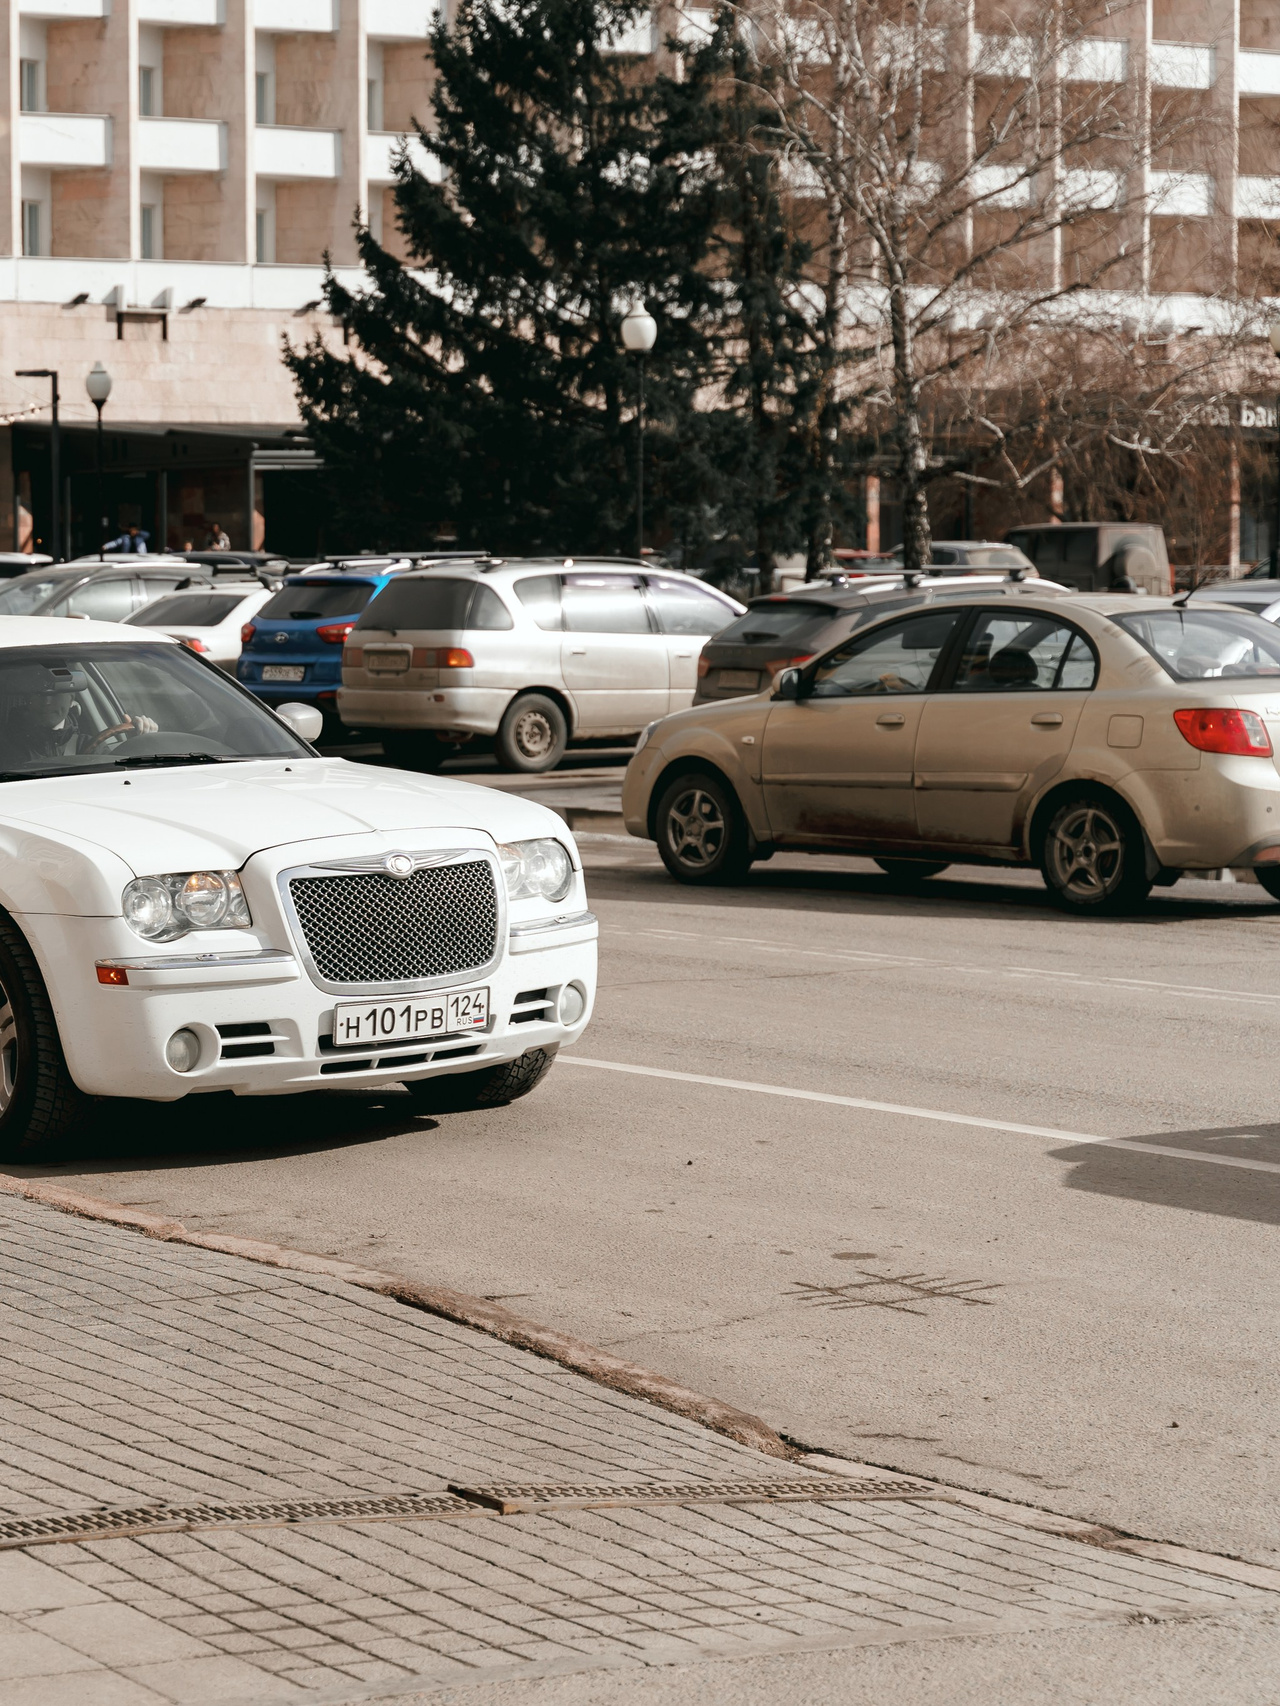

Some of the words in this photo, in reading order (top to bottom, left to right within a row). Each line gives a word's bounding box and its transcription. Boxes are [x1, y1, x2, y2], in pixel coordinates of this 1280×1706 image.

[345, 1004, 444, 1039] Н101РВ
[450, 993, 482, 1018] 124
[456, 1015, 473, 1026] RUS
